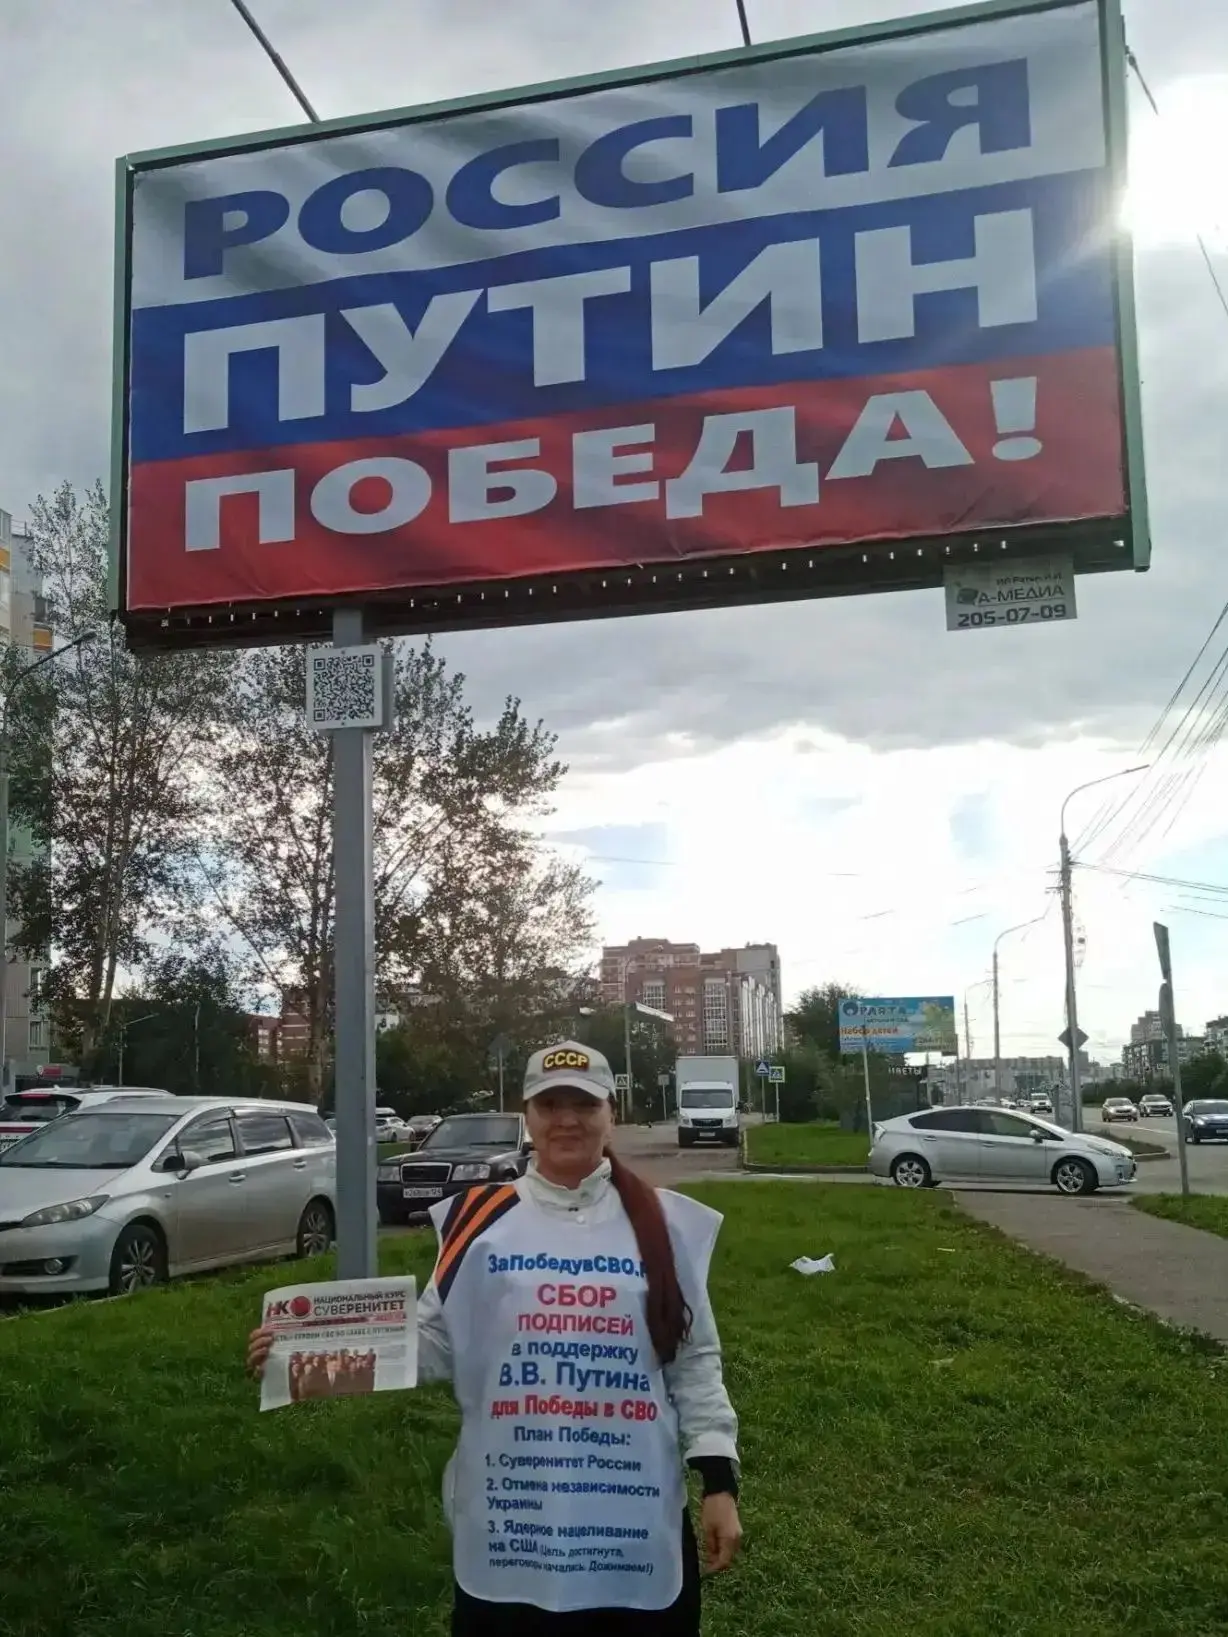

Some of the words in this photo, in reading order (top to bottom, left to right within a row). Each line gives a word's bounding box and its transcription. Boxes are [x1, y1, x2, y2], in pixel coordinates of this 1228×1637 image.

[184, 57, 1031, 280] РОССИЯ
[183, 208, 1038, 433] ПУТИН
[185, 377, 1042, 551] ПОБЕДА!
[957, 604, 1066, 627] 205-07-09
[544, 1052, 588, 1069] СССР
[313, 1292, 384, 1304] НАЦИОНАЛЬНЫЙ
[385, 1290, 406, 1299] КУРС
[537, 1283, 617, 1308] СБОР
[313, 1299, 405, 1316] СУВЕРЕНИТЕТ
[518, 1313, 634, 1336] ПОДПИСЕЙ
[511, 1343, 522, 1357] в
[527, 1341, 638, 1365] поддержку
[499, 1362, 546, 1387] В.В.
[556, 1361, 650, 1392] Путина
[491, 1401, 519, 1419] для
[525, 1395, 598, 1419] Победы
[604, 1401, 615, 1417] в
[621, 1399, 658, 1421] СВО
[514, 1426, 553, 1442] План
[559, 1427, 631, 1446] Победы:
[485, 1454, 495, 1467] 1.
[500, 1453, 584, 1470] Суверенитет
[587, 1454, 641, 1471] России
[486, 1478, 498, 1491] 2.
[502, 1477, 548, 1492] Отмена
[552, 1481, 660, 1497] независимости
[487, 1496, 543, 1512] Украины
[488, 1520, 499, 1534] 3.
[503, 1519, 554, 1537] Ядерное
[558, 1525, 649, 1540] нацеливание
[488, 1541, 506, 1553] на
[509, 1538, 539, 1554] США
